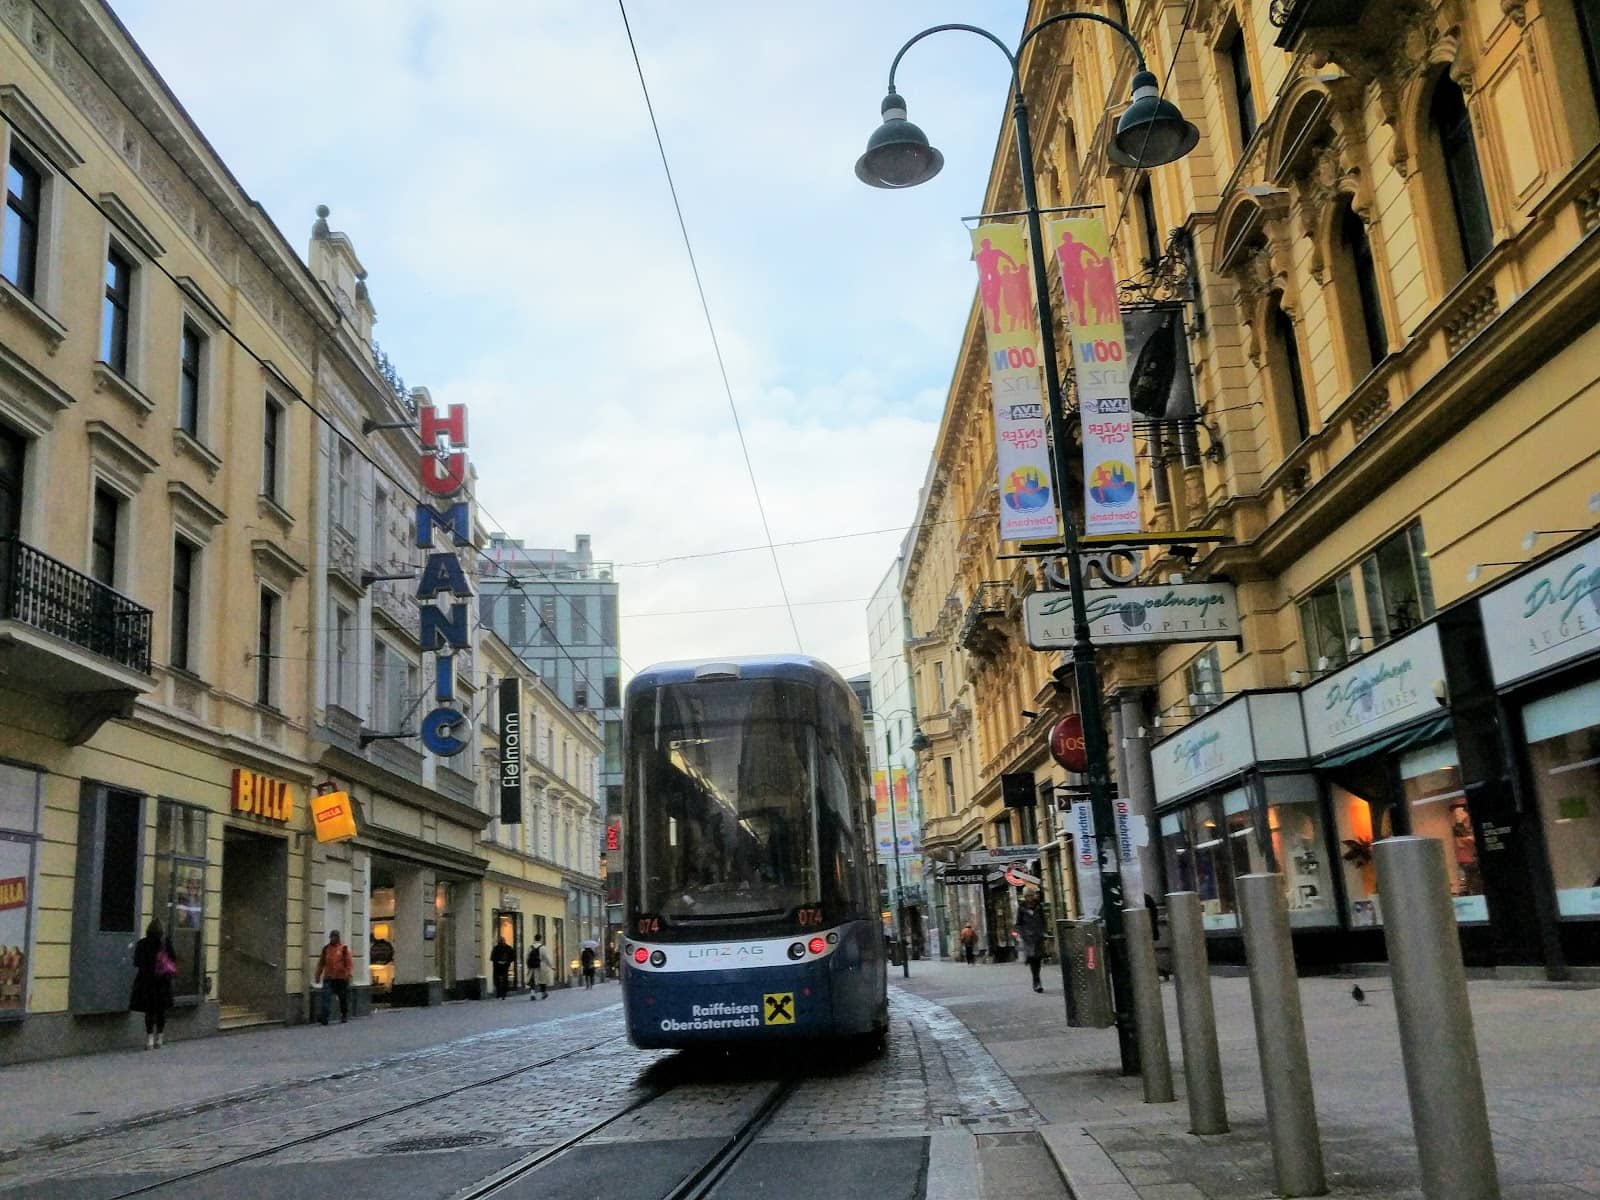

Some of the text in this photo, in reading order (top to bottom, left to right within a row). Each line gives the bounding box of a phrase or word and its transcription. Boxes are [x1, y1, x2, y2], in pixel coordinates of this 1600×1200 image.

[416, 403, 472, 757] HUMANIC
[1043, 618, 1229, 638] AUENOPTIK
[1056, 732, 1085, 756] jos
[234, 768, 293, 822] BILLA
[0, 882, 24, 904] ILLA
[638, 918, 660, 935] 074
[798, 909, 822, 926] 074
[736, 945, 764, 956] AG
[692, 1002, 759, 1018] Raiffeisen
[660, 1014, 760, 1032] Oberösterreich
